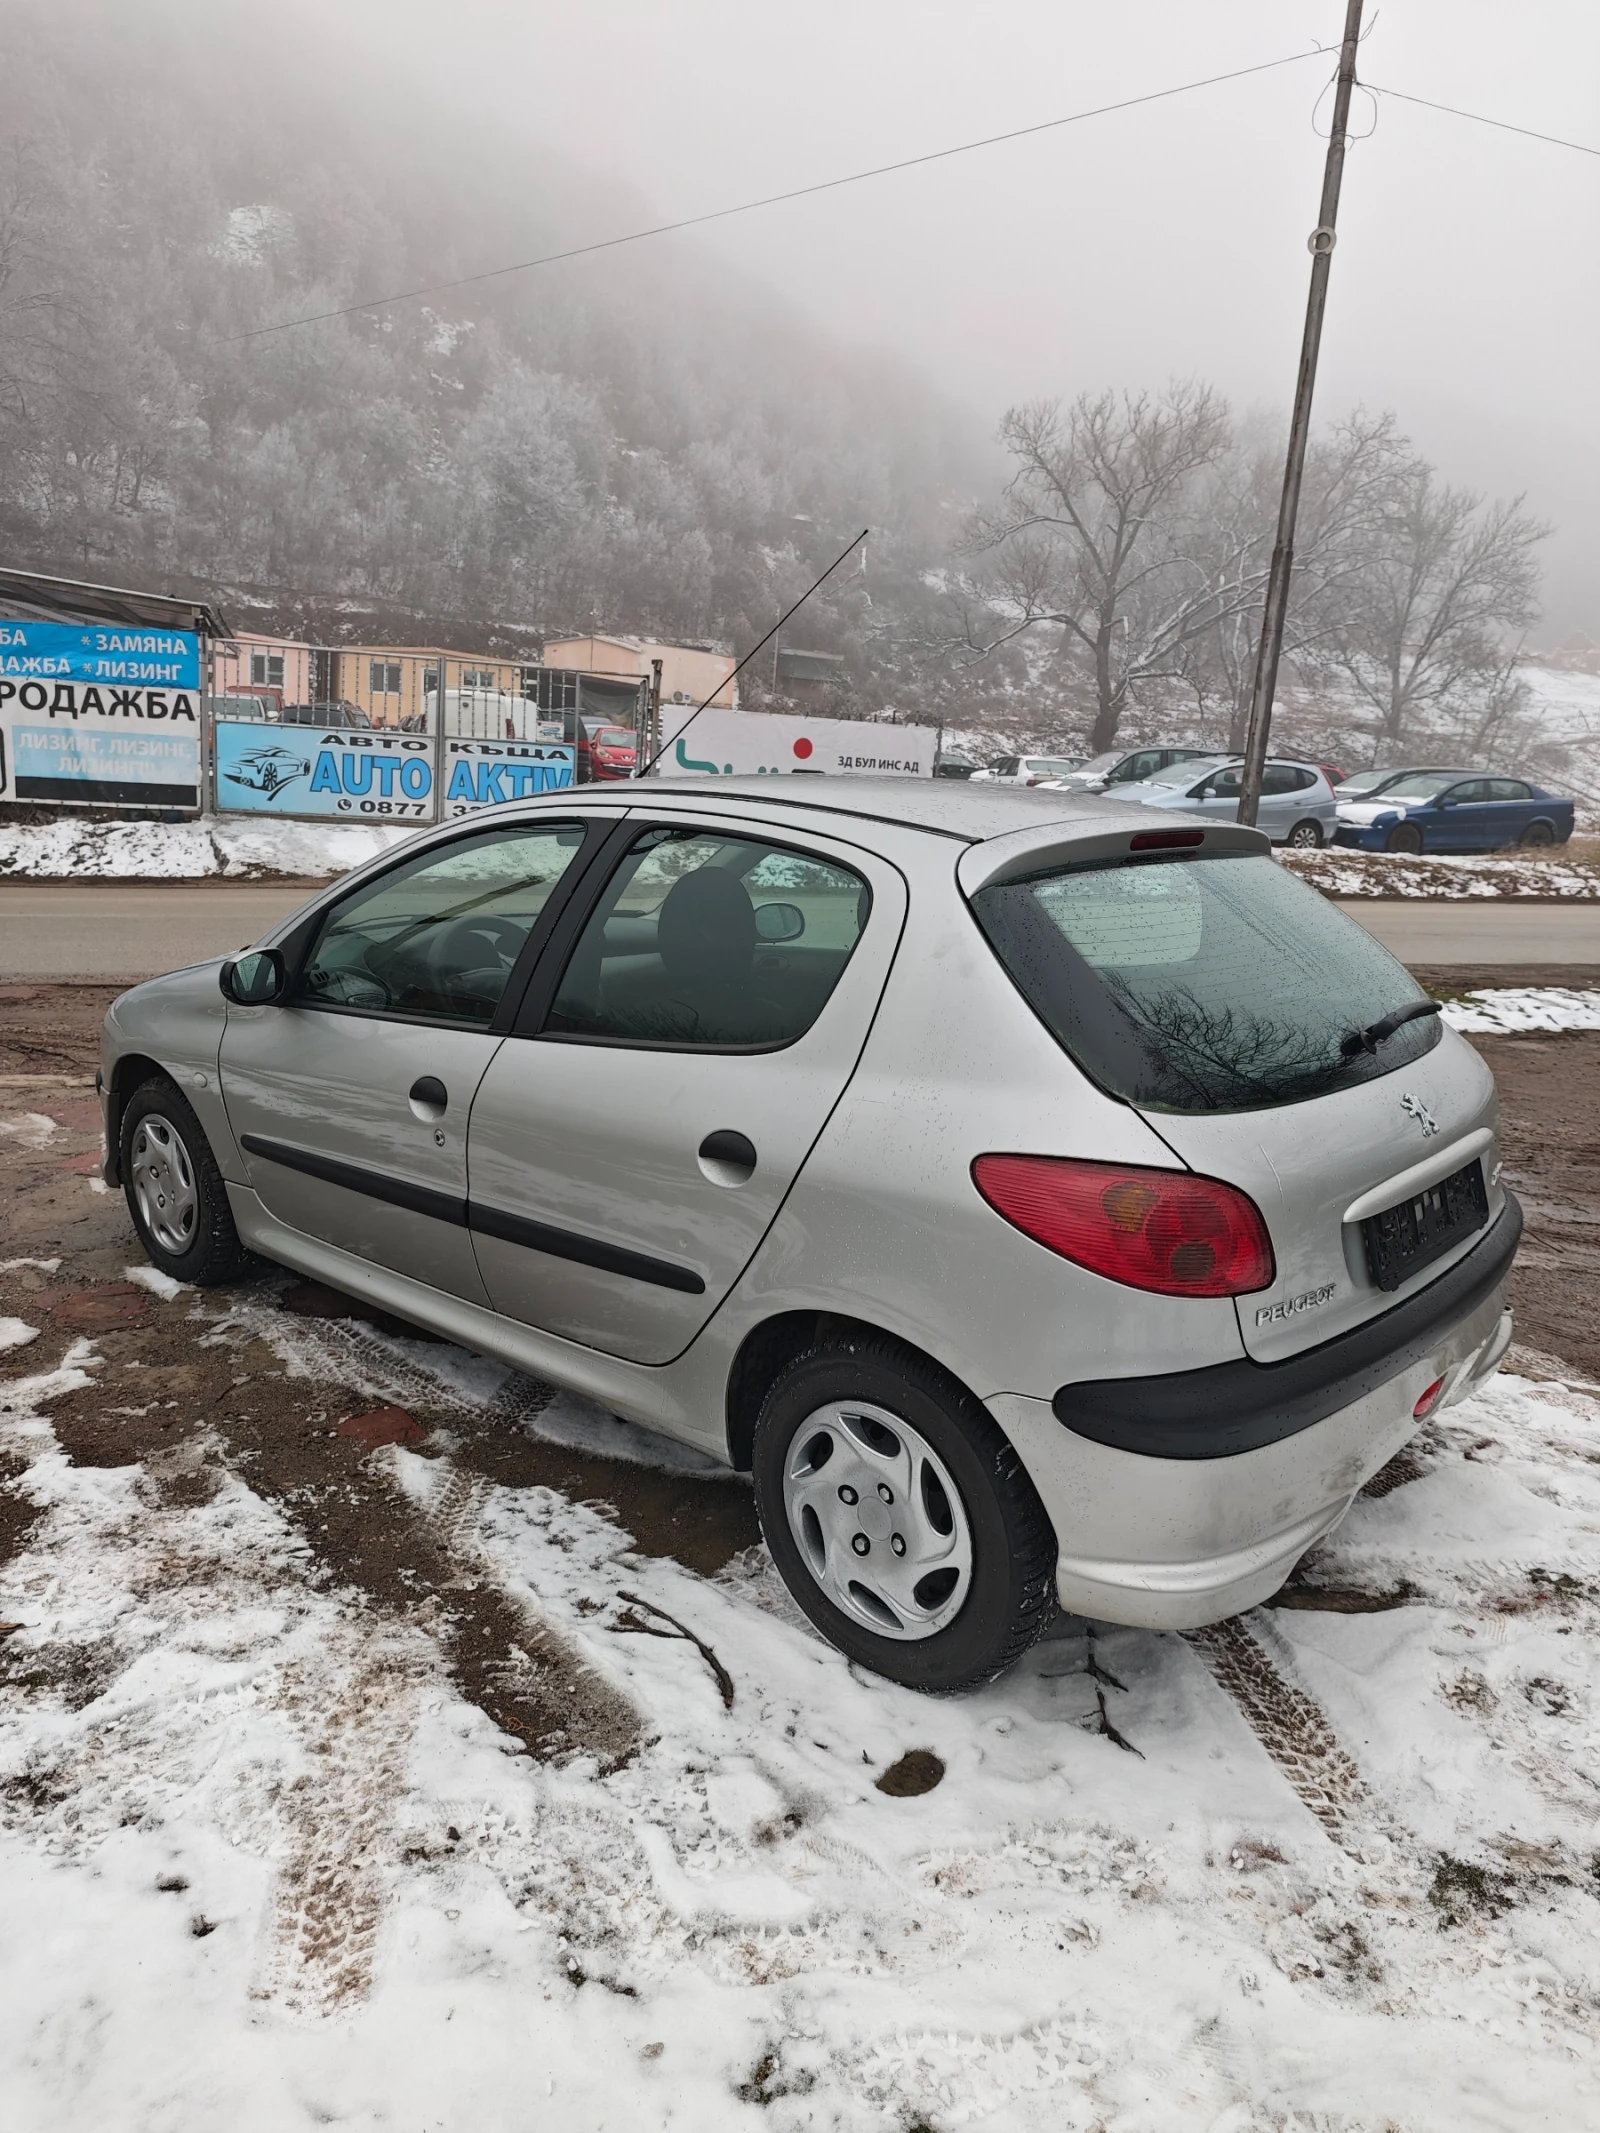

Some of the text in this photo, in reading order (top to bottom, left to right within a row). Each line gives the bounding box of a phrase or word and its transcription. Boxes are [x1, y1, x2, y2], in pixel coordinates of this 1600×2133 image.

[95, 634, 188, 655] ЗАМЯНА
[95, 660, 182, 680] ЛИЗИНГ
[19, 733, 104, 755] ЛИЗИНГ,
[320, 734, 569, 760] АВТО КЪЩА
[309, 751, 432, 800] AUTO
[855, 757, 876, 769] БУЛ
[878, 759, 902, 770] ИНС
[903, 761, 919, 774] АД
[360, 800, 426, 816] 0877
[1256, 1283, 1337, 1326] PEUGEOT
